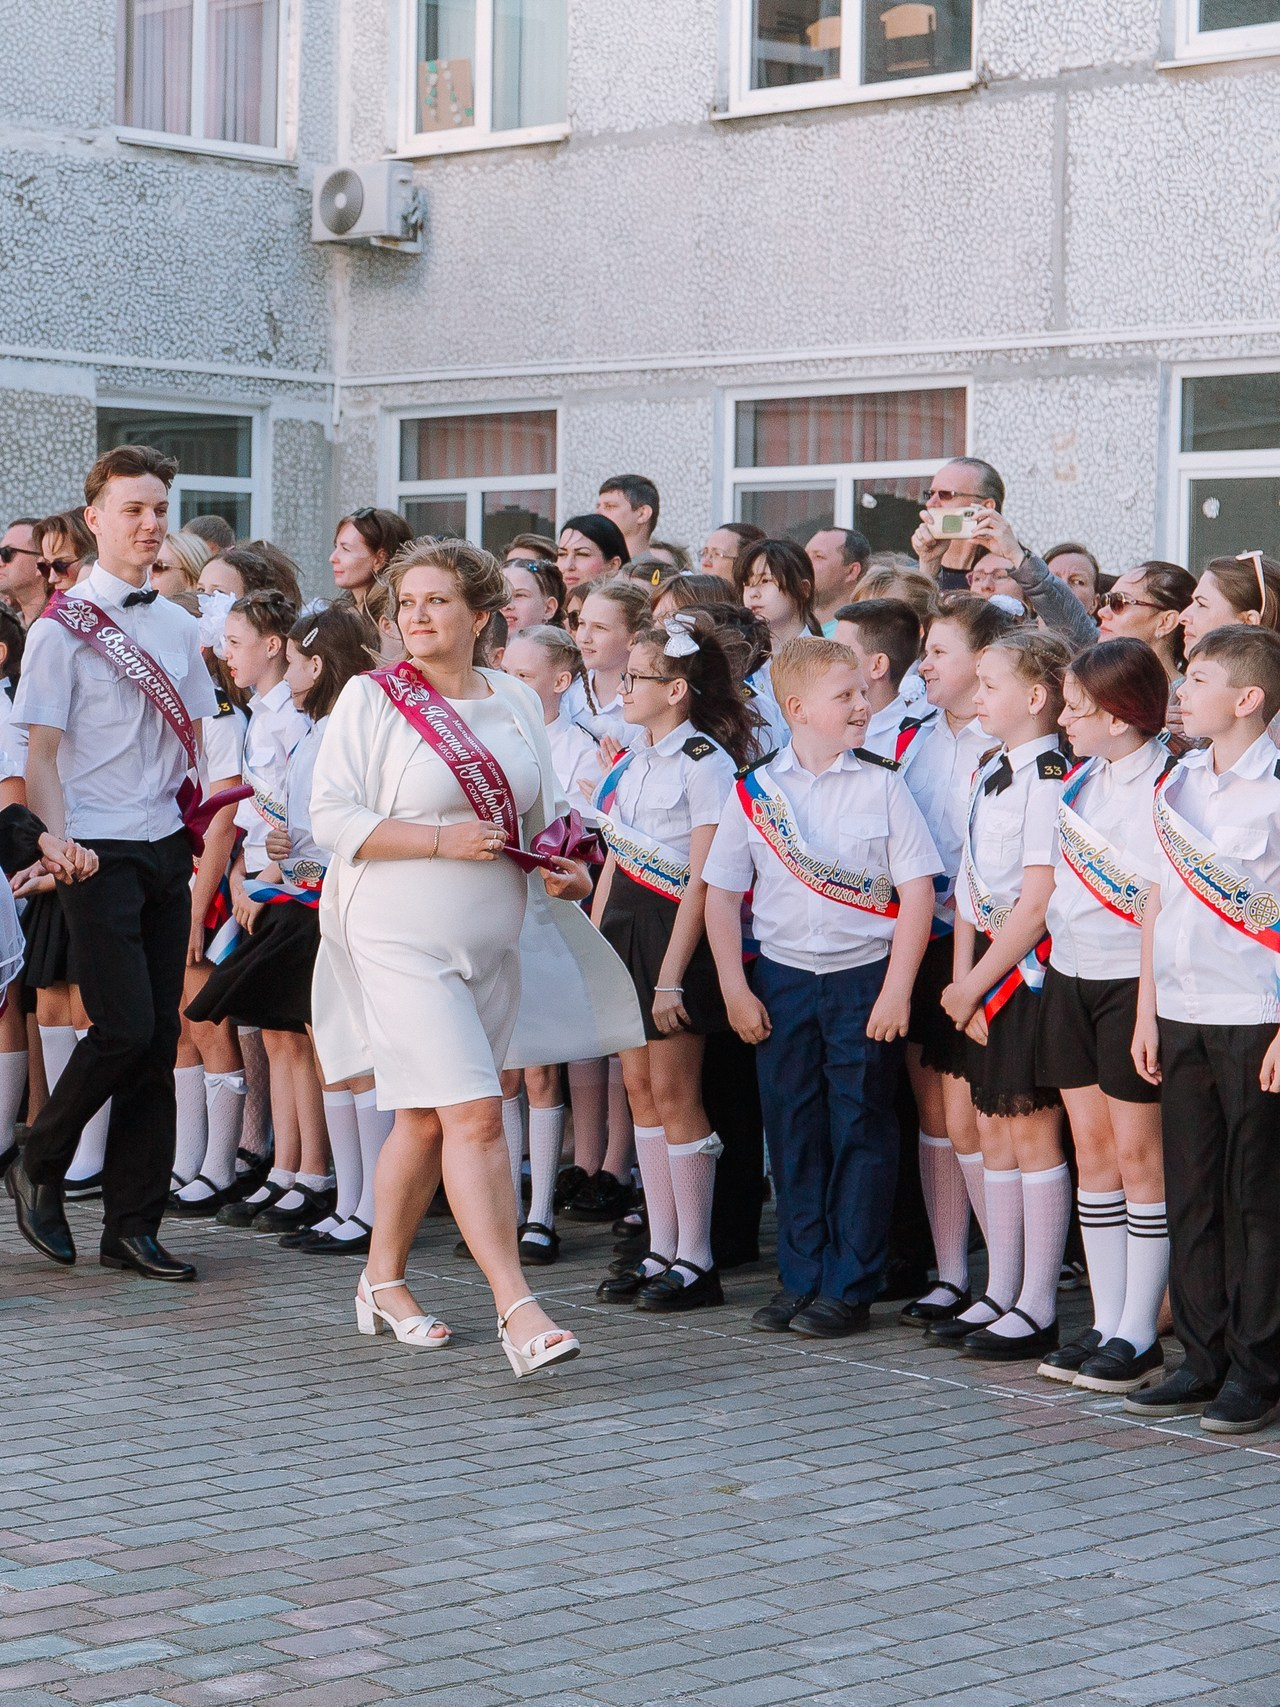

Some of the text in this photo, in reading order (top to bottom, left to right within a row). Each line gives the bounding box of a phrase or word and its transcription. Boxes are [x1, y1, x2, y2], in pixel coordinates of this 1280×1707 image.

[96, 626, 185, 725] Выпускник
[105, 650, 126, 666] МАОУ
[420, 705, 475, 762] Классный
[452, 719, 488, 761] Мельникова
[486, 761, 503, 786] Елена
[692, 743, 710, 755] 33
[436, 742, 457, 763] МАОУ
[466, 782, 482, 804] СОШ
[1044, 765, 1063, 776] 33
[777, 822, 872, 896] Выпускник
[823, 884, 874, 909] школы
[1082, 868, 1132, 914] школы
[1188, 873, 1243, 923] школы
